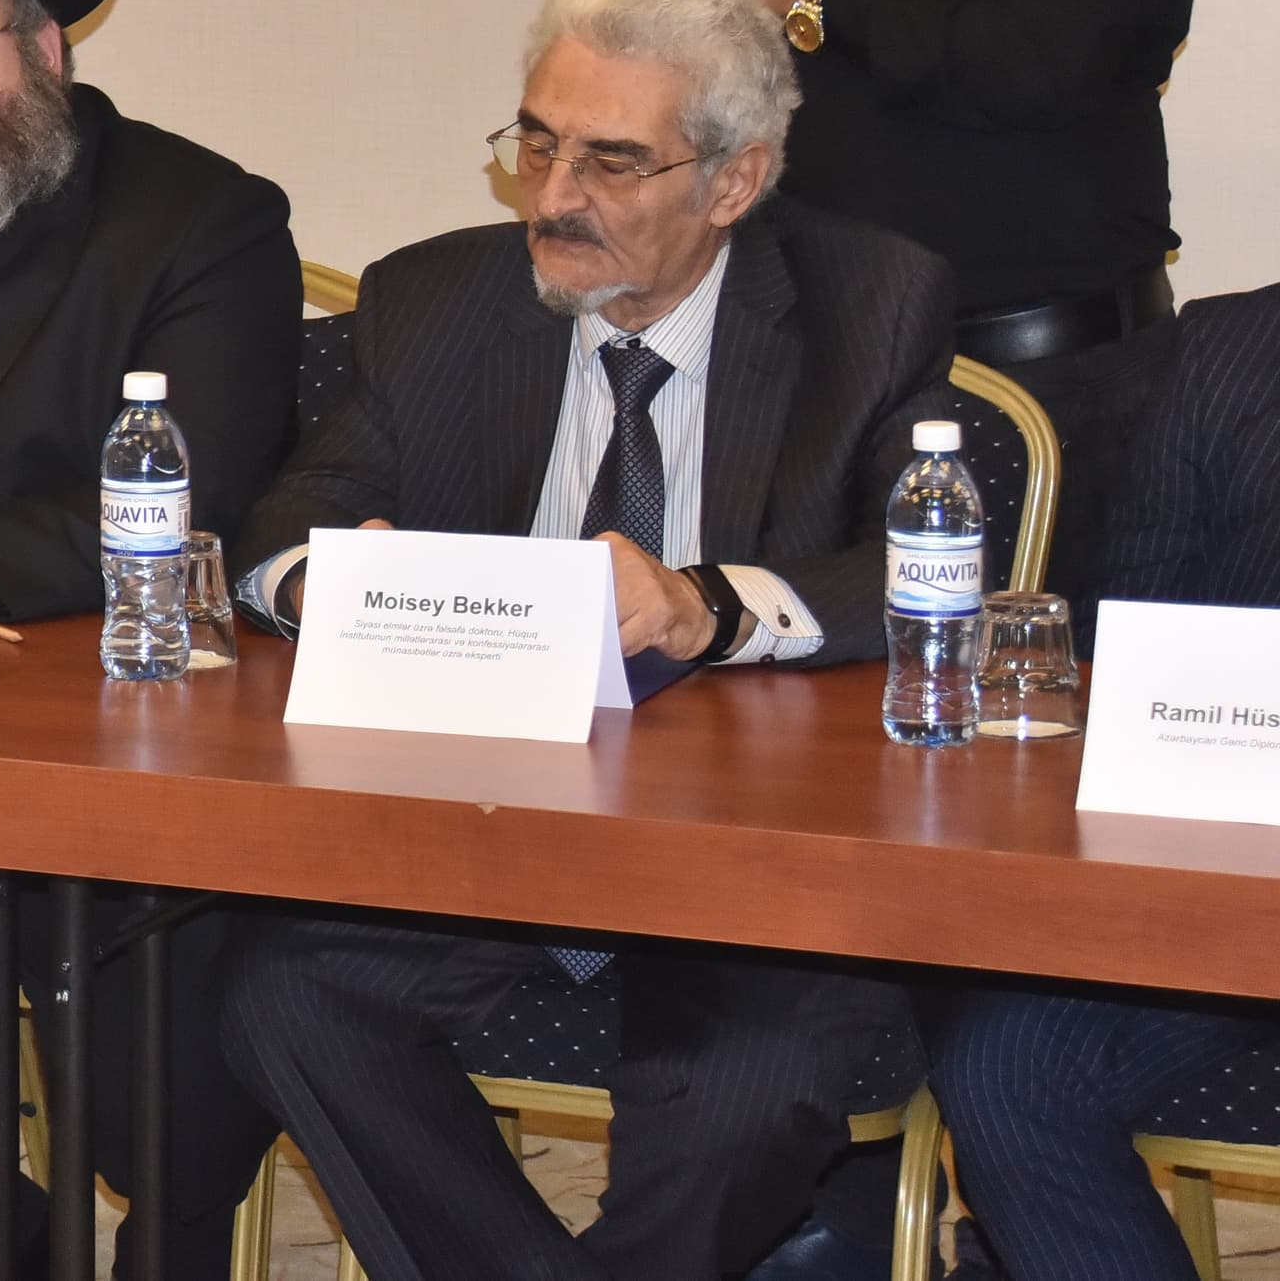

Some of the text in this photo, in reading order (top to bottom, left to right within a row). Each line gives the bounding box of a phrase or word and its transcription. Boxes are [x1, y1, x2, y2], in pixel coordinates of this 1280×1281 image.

[897, 561, 979, 582] AQUAVITA
[364, 591, 533, 618] Moisey Bekker
[1150, 702, 1222, 724] Ramil
